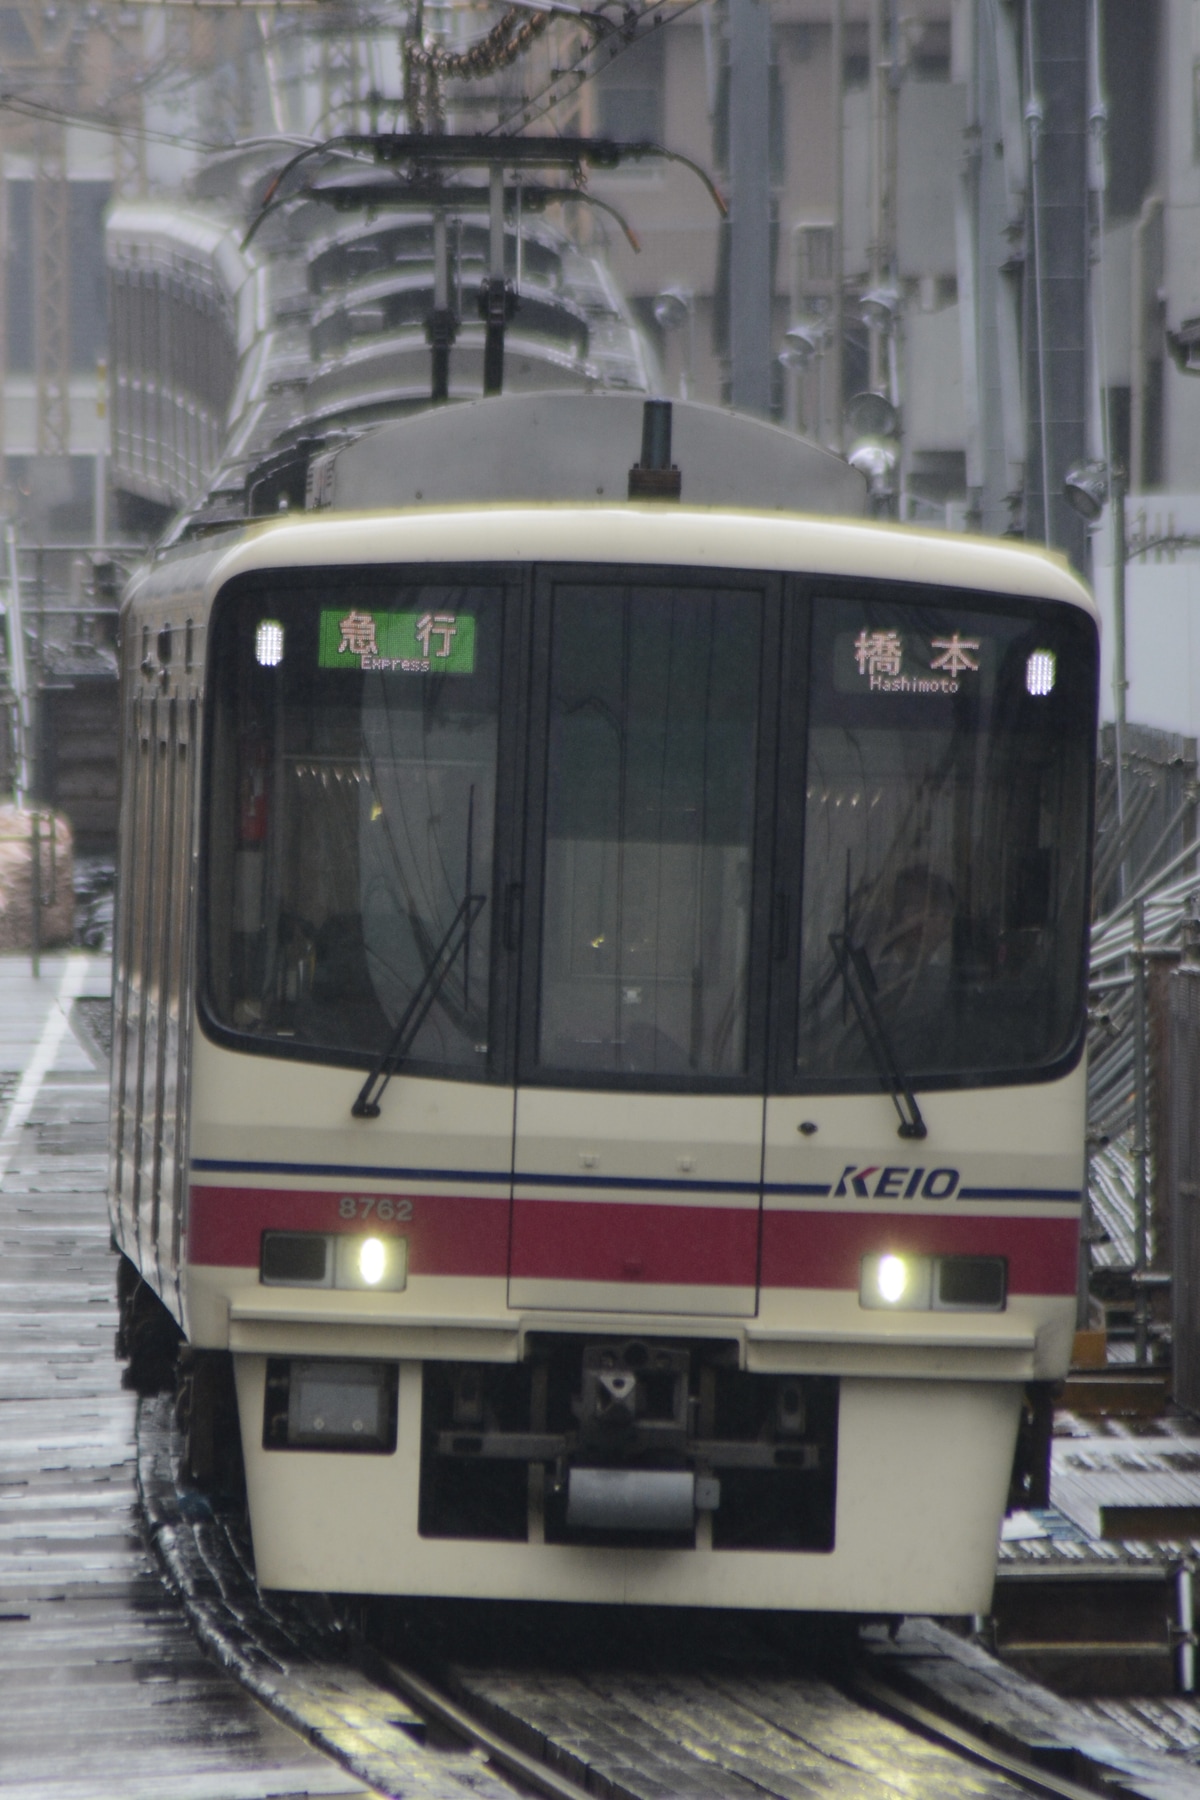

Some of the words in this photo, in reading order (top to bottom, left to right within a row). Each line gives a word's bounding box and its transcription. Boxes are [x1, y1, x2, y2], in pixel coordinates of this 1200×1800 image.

[338, 611, 457, 657] 急行
[361, 655, 430, 672] Express
[854, 630, 980, 678] 橋本
[869, 675, 959, 693] Hashimoto
[833, 1165, 960, 1200] KEIO
[338, 1197, 413, 1222] 8762
